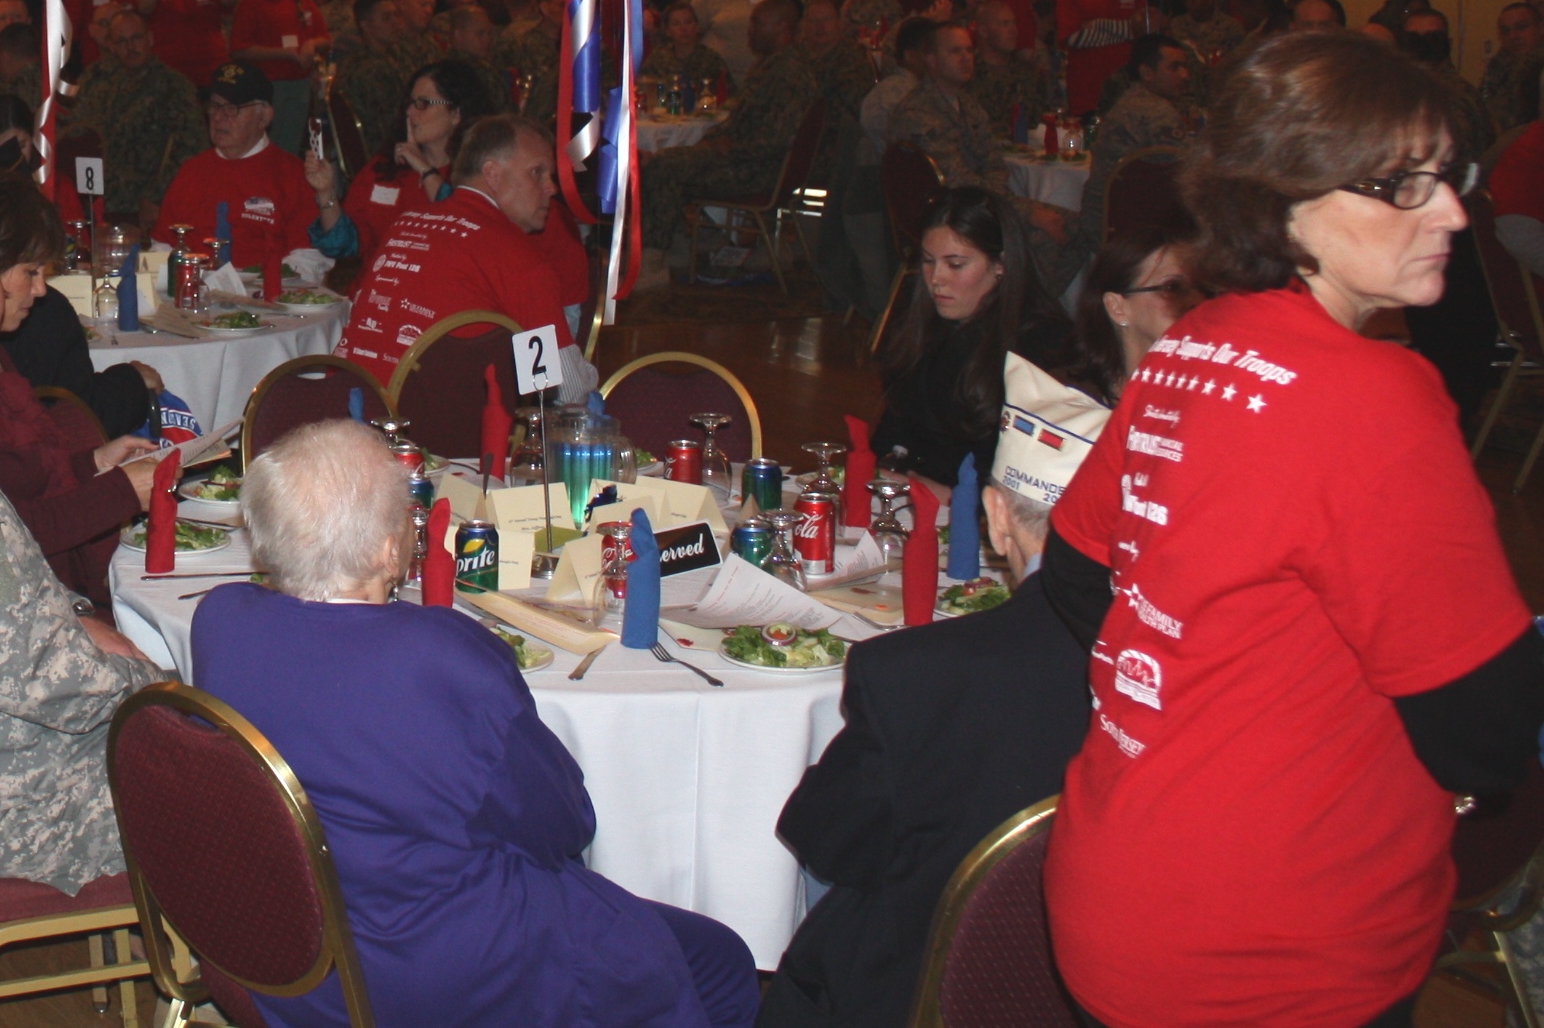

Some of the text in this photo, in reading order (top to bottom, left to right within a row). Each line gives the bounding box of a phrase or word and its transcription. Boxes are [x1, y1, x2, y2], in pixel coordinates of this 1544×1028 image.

[85, 166, 95, 191] 8
[457, 218, 480, 231] Troops
[529, 335, 547, 376] 2
[1176, 336, 1216, 361] Supports
[1212, 343, 1241, 364] Our
[1233, 349, 1298, 385] Troops
[1005, 465, 1066, 496] COMMANDE
[1042, 493, 1060, 504] 20
[793, 513, 825, 549] ola
[456, 545, 496, 578] prite
[659, 533, 705, 563] erved
